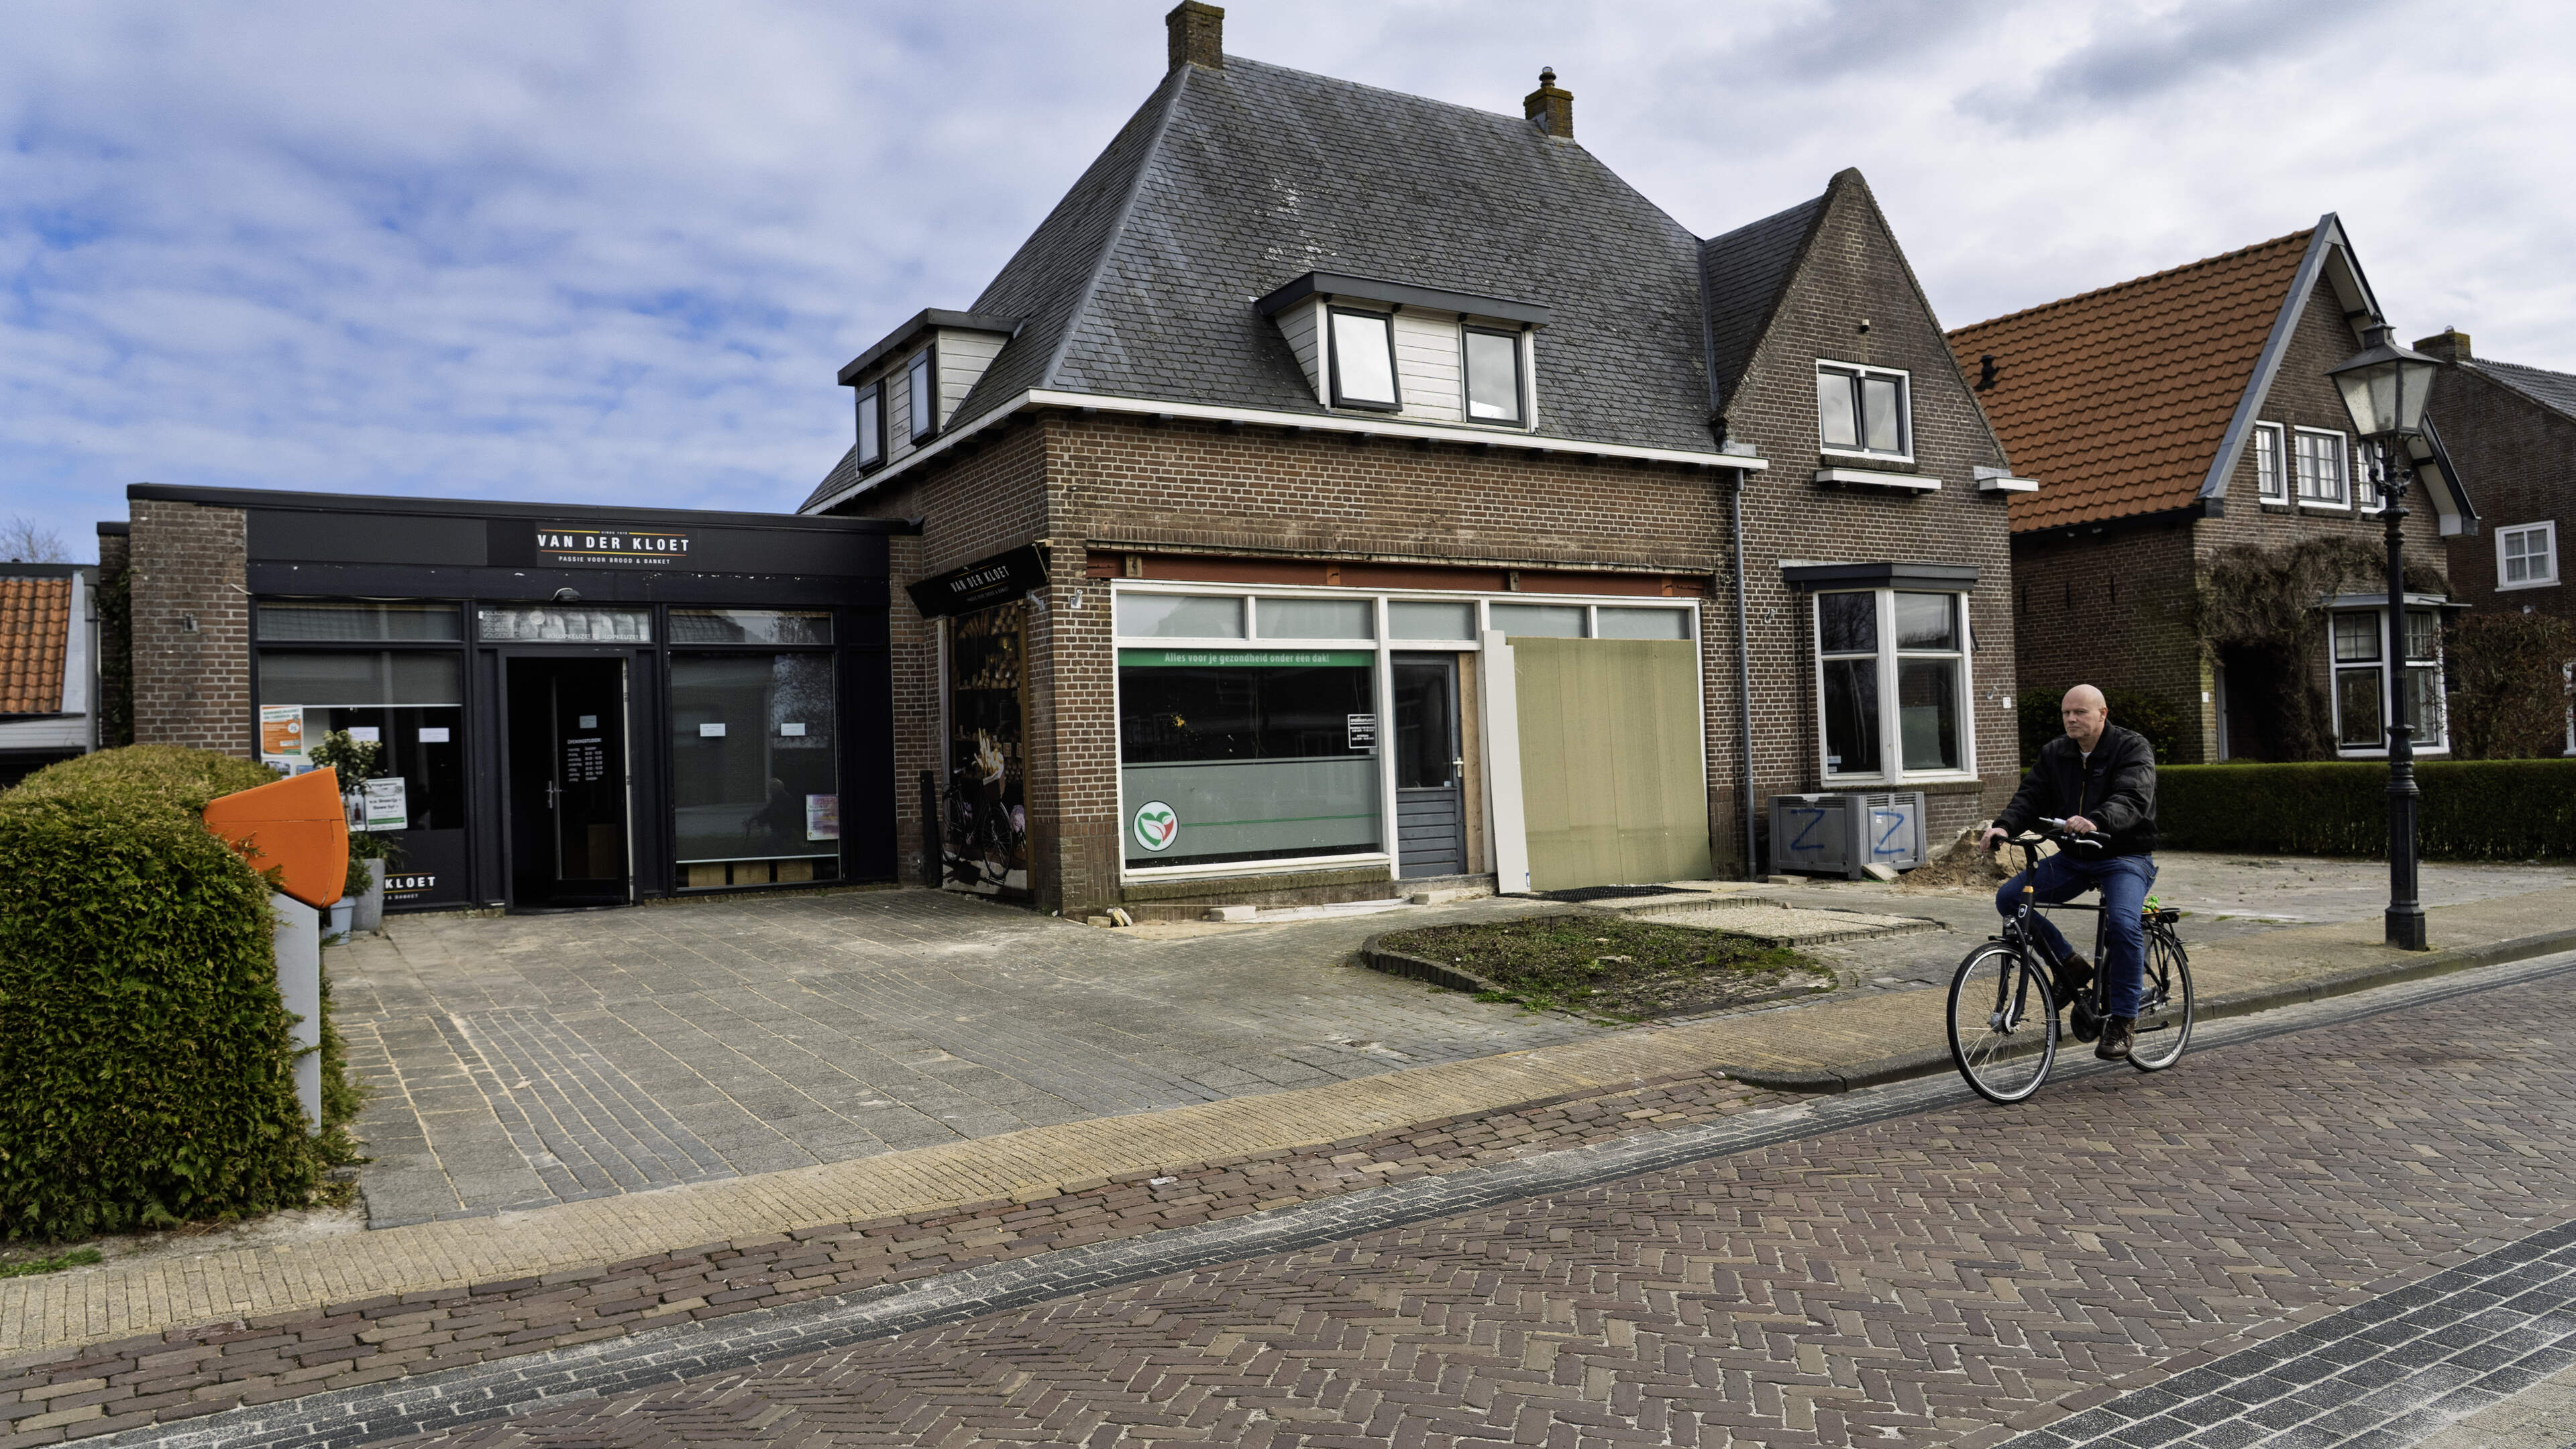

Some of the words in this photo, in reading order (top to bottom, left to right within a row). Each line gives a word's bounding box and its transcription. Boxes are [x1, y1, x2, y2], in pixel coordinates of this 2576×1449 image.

[537, 534, 573, 547] VAN
[586, 536, 621, 549] DER
[633, 538, 689, 551] KLOET
[950, 580, 967, 592] VAN
[967, 574, 983, 588] DER
[983, 566, 1009, 582] KLOET
[1165, 653, 1186, 662] Alles
[1208, 653, 1218, 664] je
[1220, 653, 1268, 665] gezondheid
[1270, 653, 1293, 663] onder
[1295, 653, 1310, 663] één
[1312, 653, 1330, 663] dak!
[1790, 809, 1825, 851] Z
[385, 876, 435, 889] KLOET
